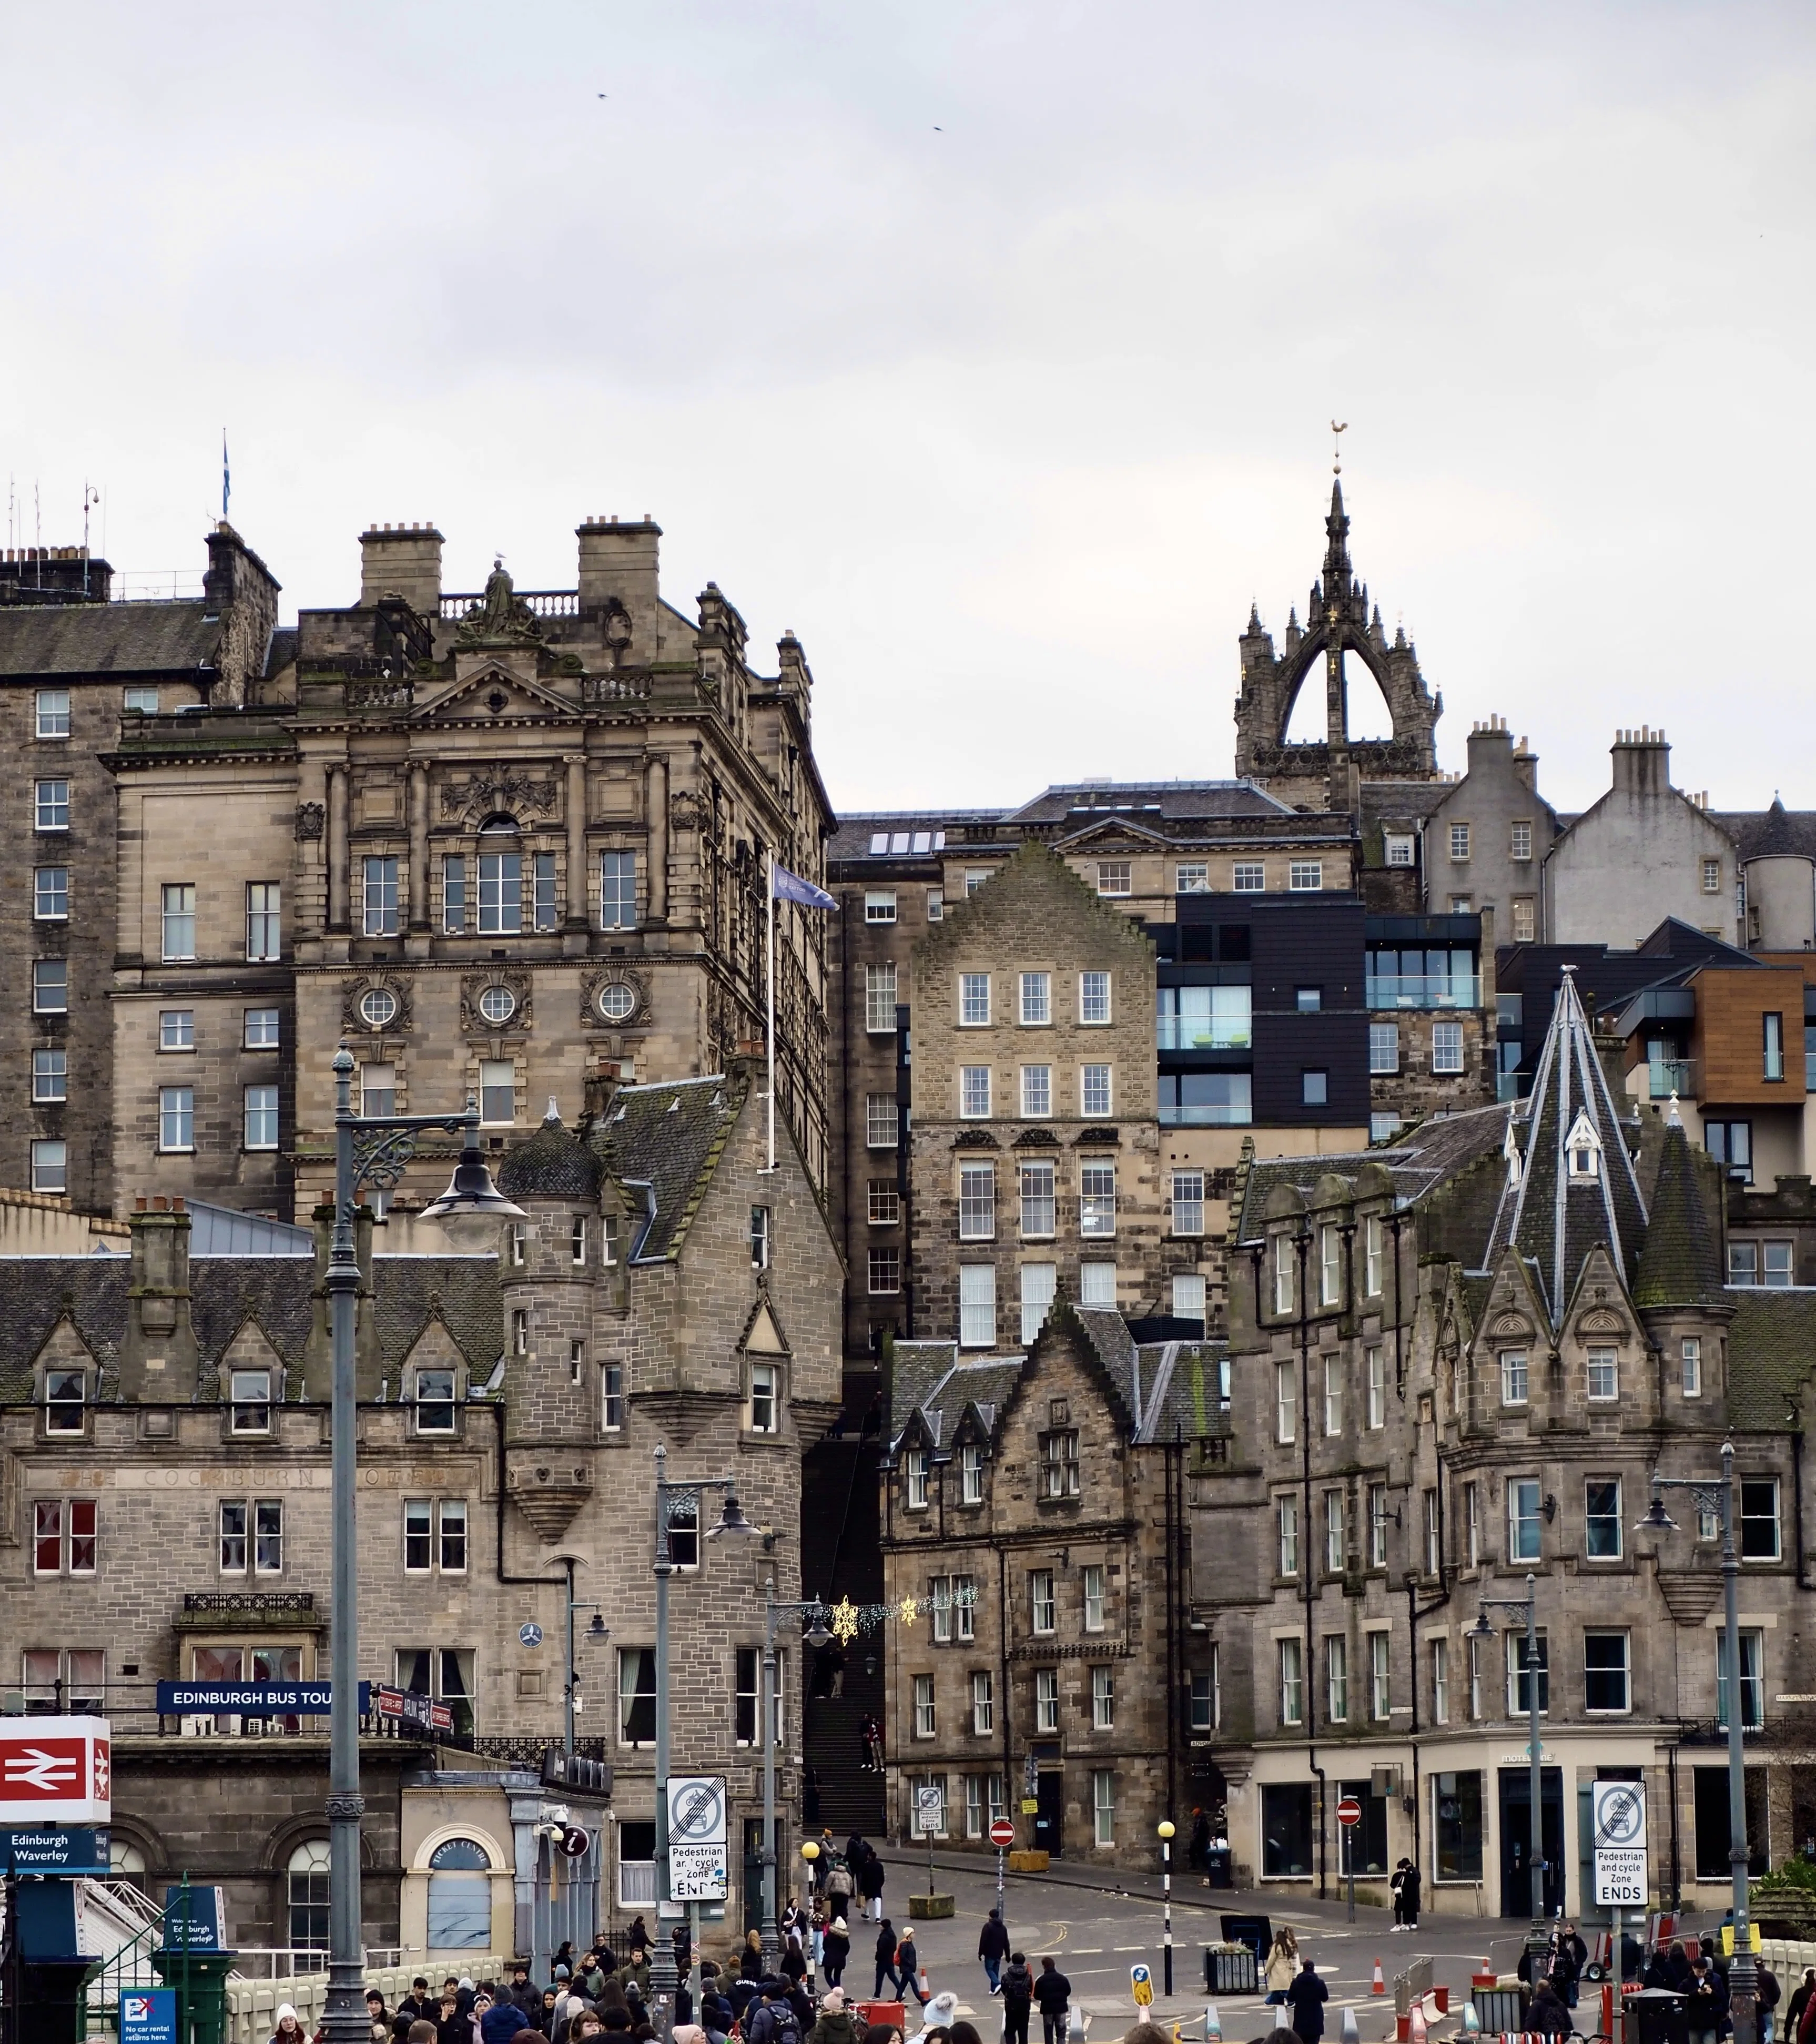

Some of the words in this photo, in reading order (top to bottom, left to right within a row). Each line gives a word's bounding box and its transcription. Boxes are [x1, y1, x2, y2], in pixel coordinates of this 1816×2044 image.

[57, 1471, 116, 1486] THE
[366, 1469, 443, 1485] OTEL
[173, 1692, 262, 1704] EDINBURGH
[267, 1692, 297, 1704] BUS
[300, 1692, 332, 1704] TOU
[12, 1835, 68, 1848] Edinburgh
[15, 1850, 68, 1863] Waverley
[433, 1841, 456, 1863] TICKET
[461, 1841, 487, 1863] CENTRE
[673, 1847, 723, 1857] Pedestrian
[1598, 1852, 1643, 1860] Pedestrian
[676, 1858, 693, 1868] an
[695, 1857, 719, 1869] cycle
[1601, 1863, 1617, 1871] and
[1619, 1863, 1640, 1873] cycle
[686, 1869, 709, 1878] Zone
[1611, 1874, 1631, 1883] Zone
[1602, 1887, 1641, 1899] ENDS
[174, 1925, 210, 1935] Edburgh
[175, 1935, 209, 1944] verley
